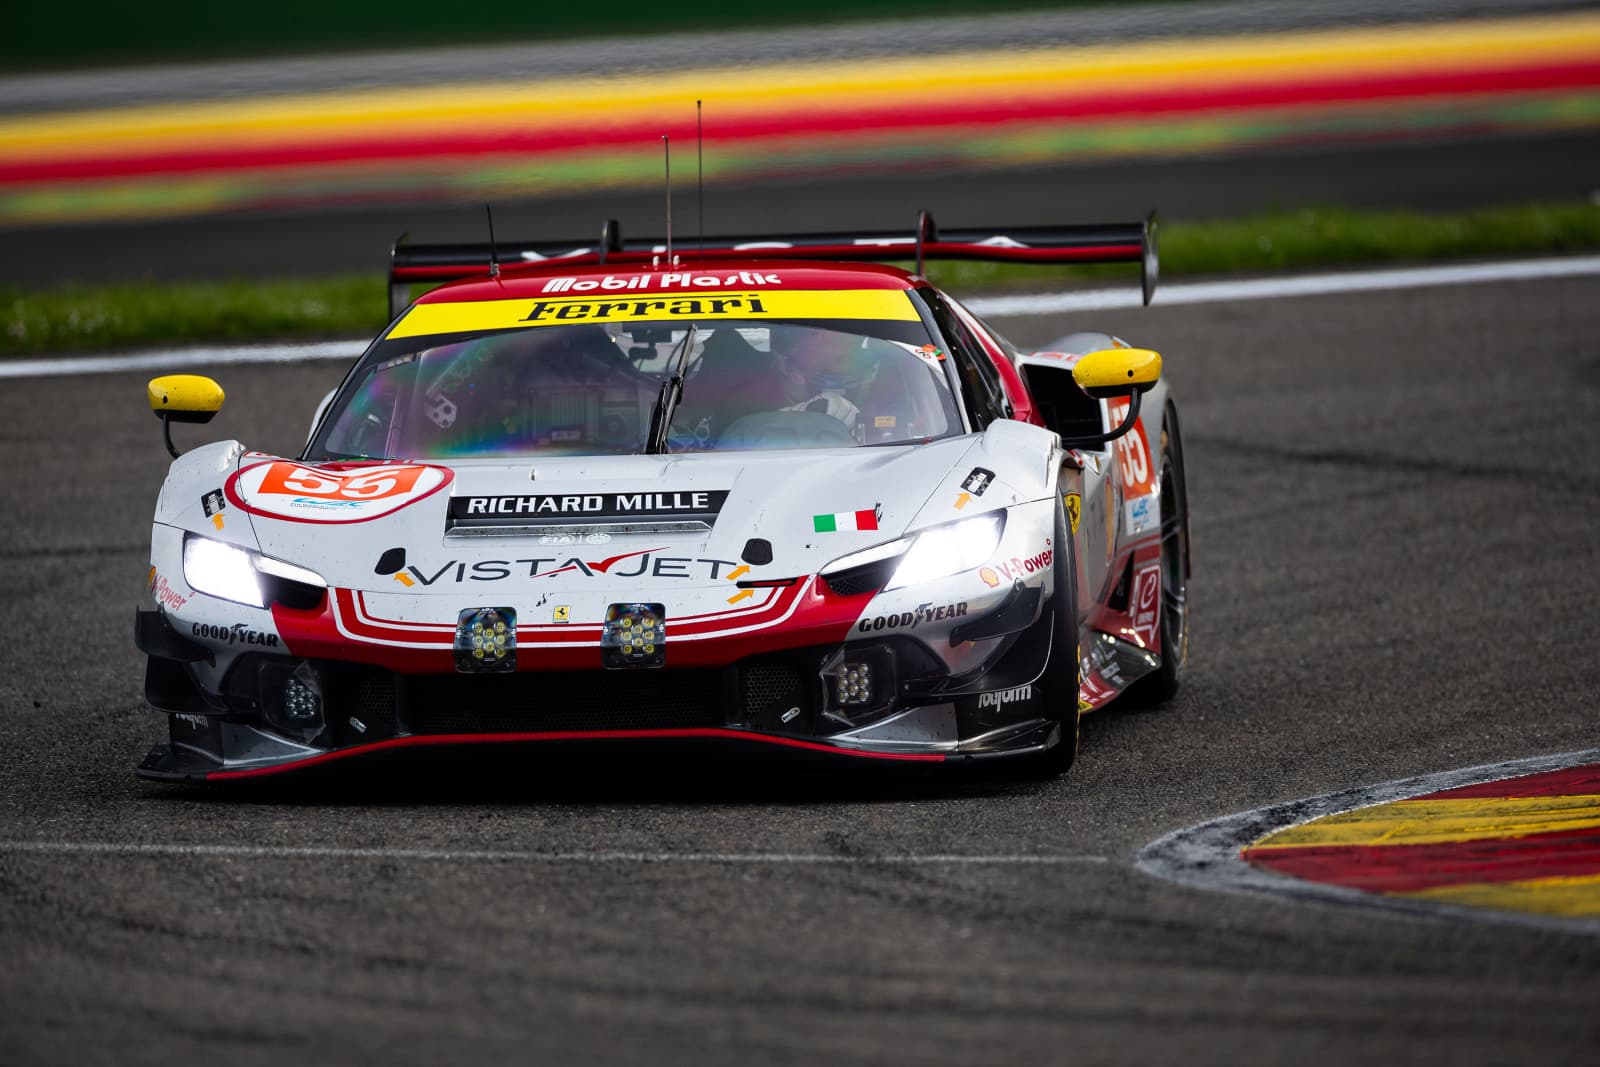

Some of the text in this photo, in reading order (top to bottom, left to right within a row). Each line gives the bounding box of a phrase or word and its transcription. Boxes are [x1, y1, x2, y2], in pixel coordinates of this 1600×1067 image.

[541, 271, 782, 293] Mobil Plastic
[518, 294, 768, 322] Ferrari
[283, 467, 401, 498] 55
[467, 492, 709, 514] RICHARD MILLE
[858, 602, 969, 632] GOODYEAR
[192, 622, 279, 648] GOODYEAR
